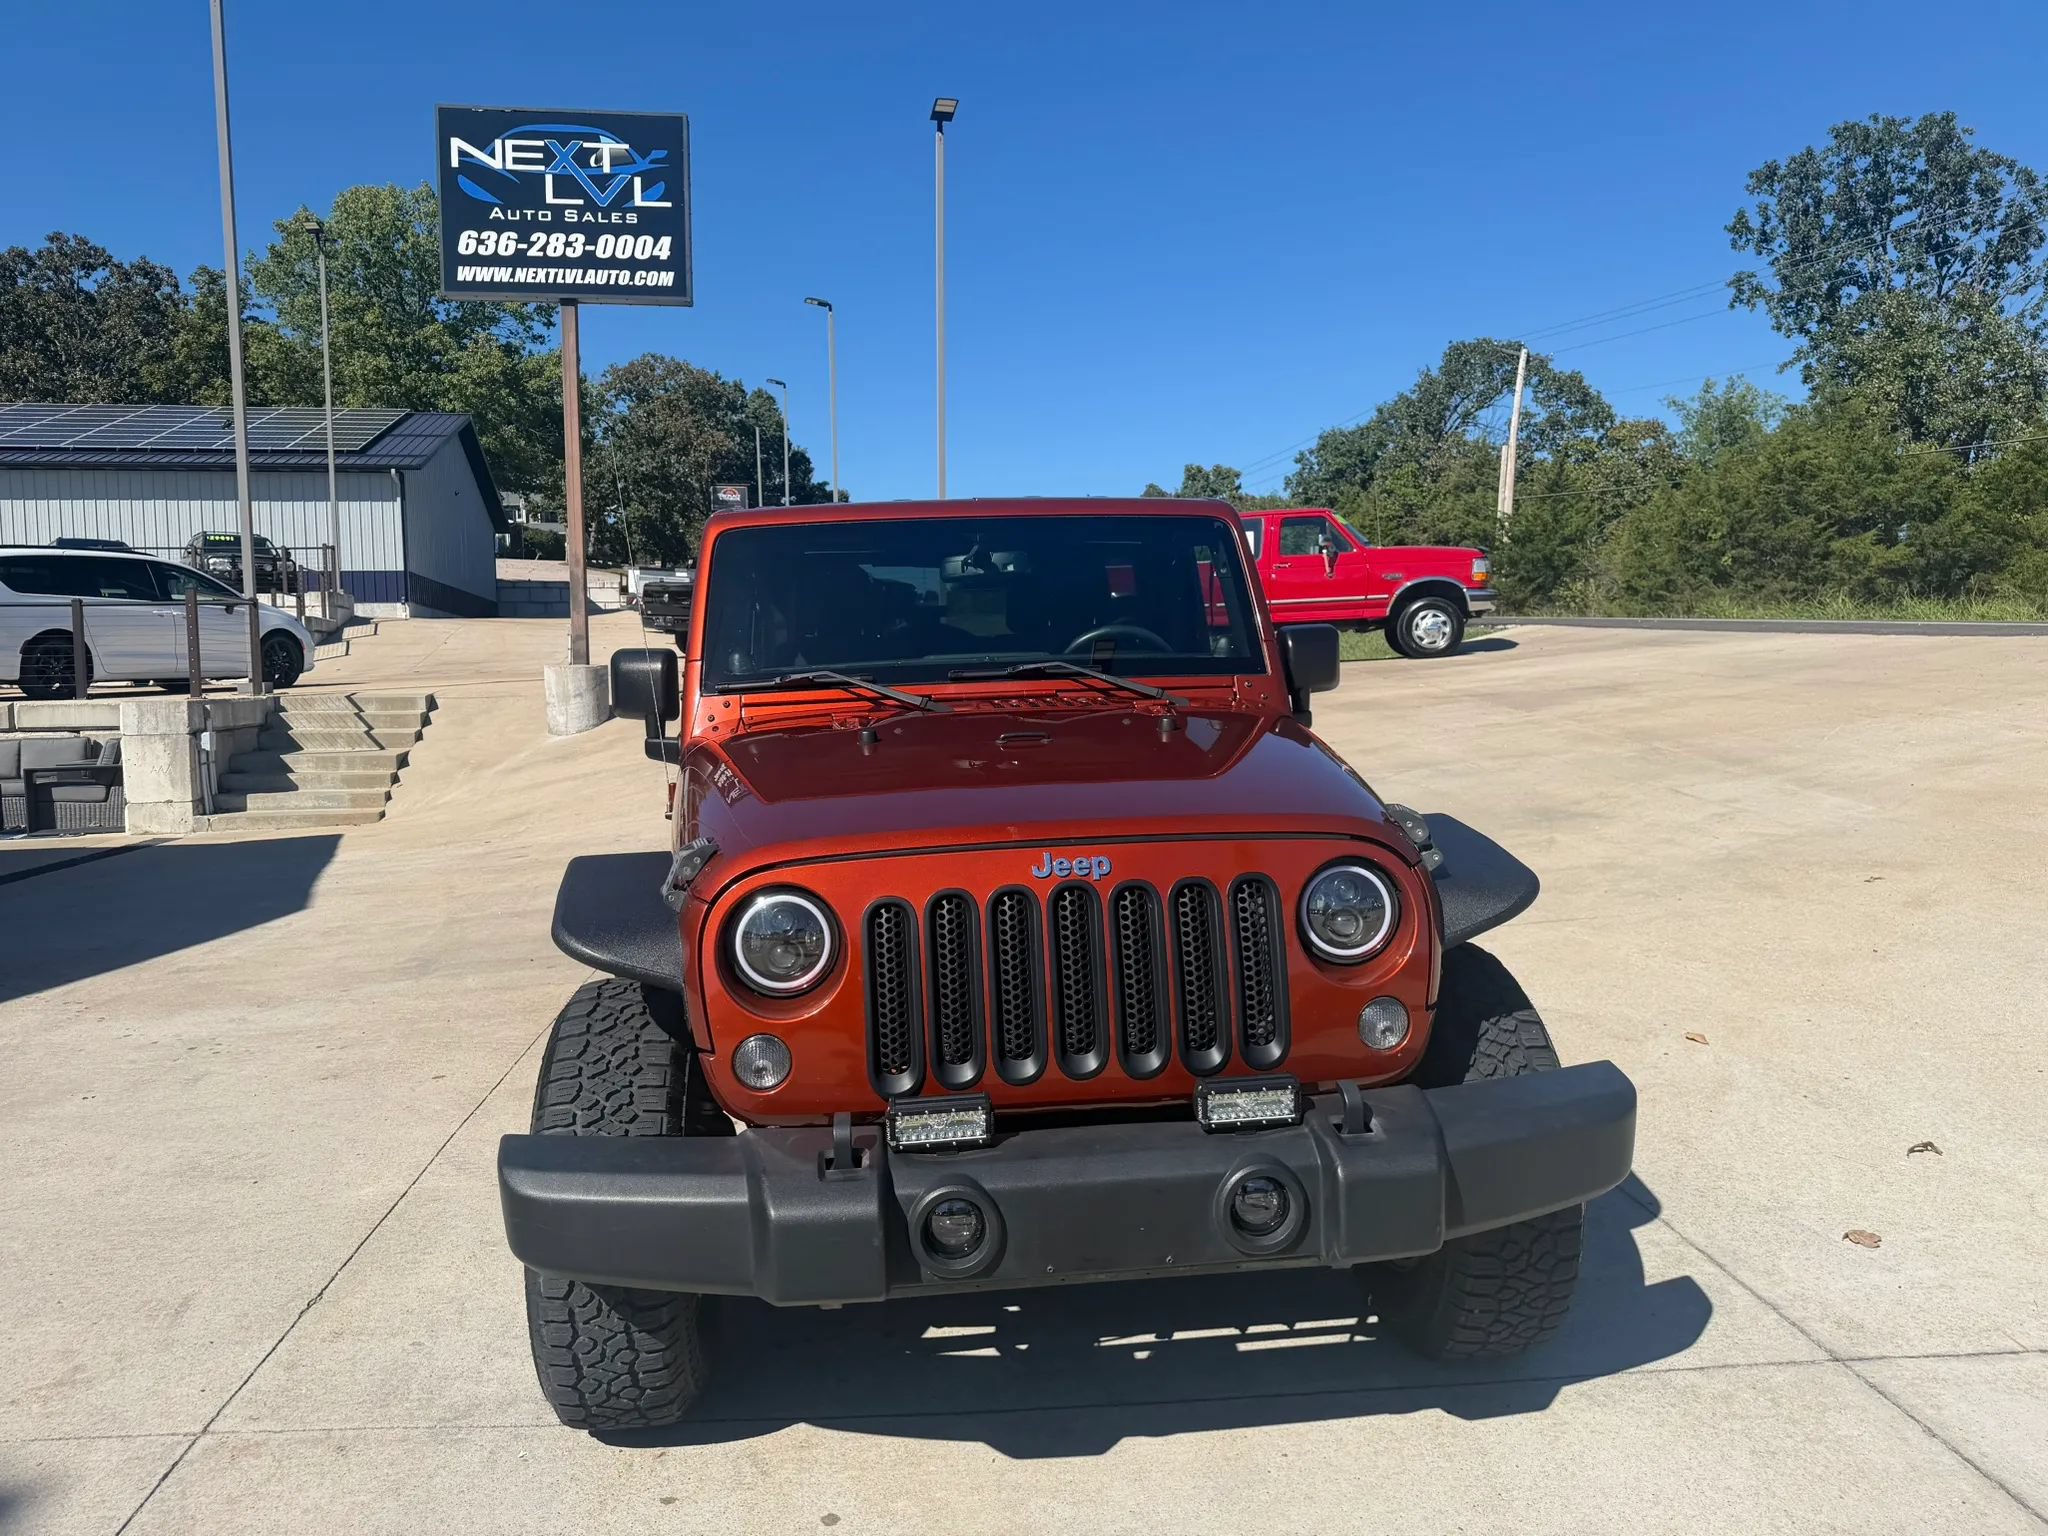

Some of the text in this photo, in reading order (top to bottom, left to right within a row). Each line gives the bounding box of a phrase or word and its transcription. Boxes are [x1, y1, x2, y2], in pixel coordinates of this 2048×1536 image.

[450, 136, 629, 174] NEXT
[544, 173, 672, 207] LVL
[457, 229, 672, 261] 636-283-0004
[456, 265, 675, 287] WWW.NEXTLVLAUTO.COM
[1032, 851, 1112, 881] Jeep
